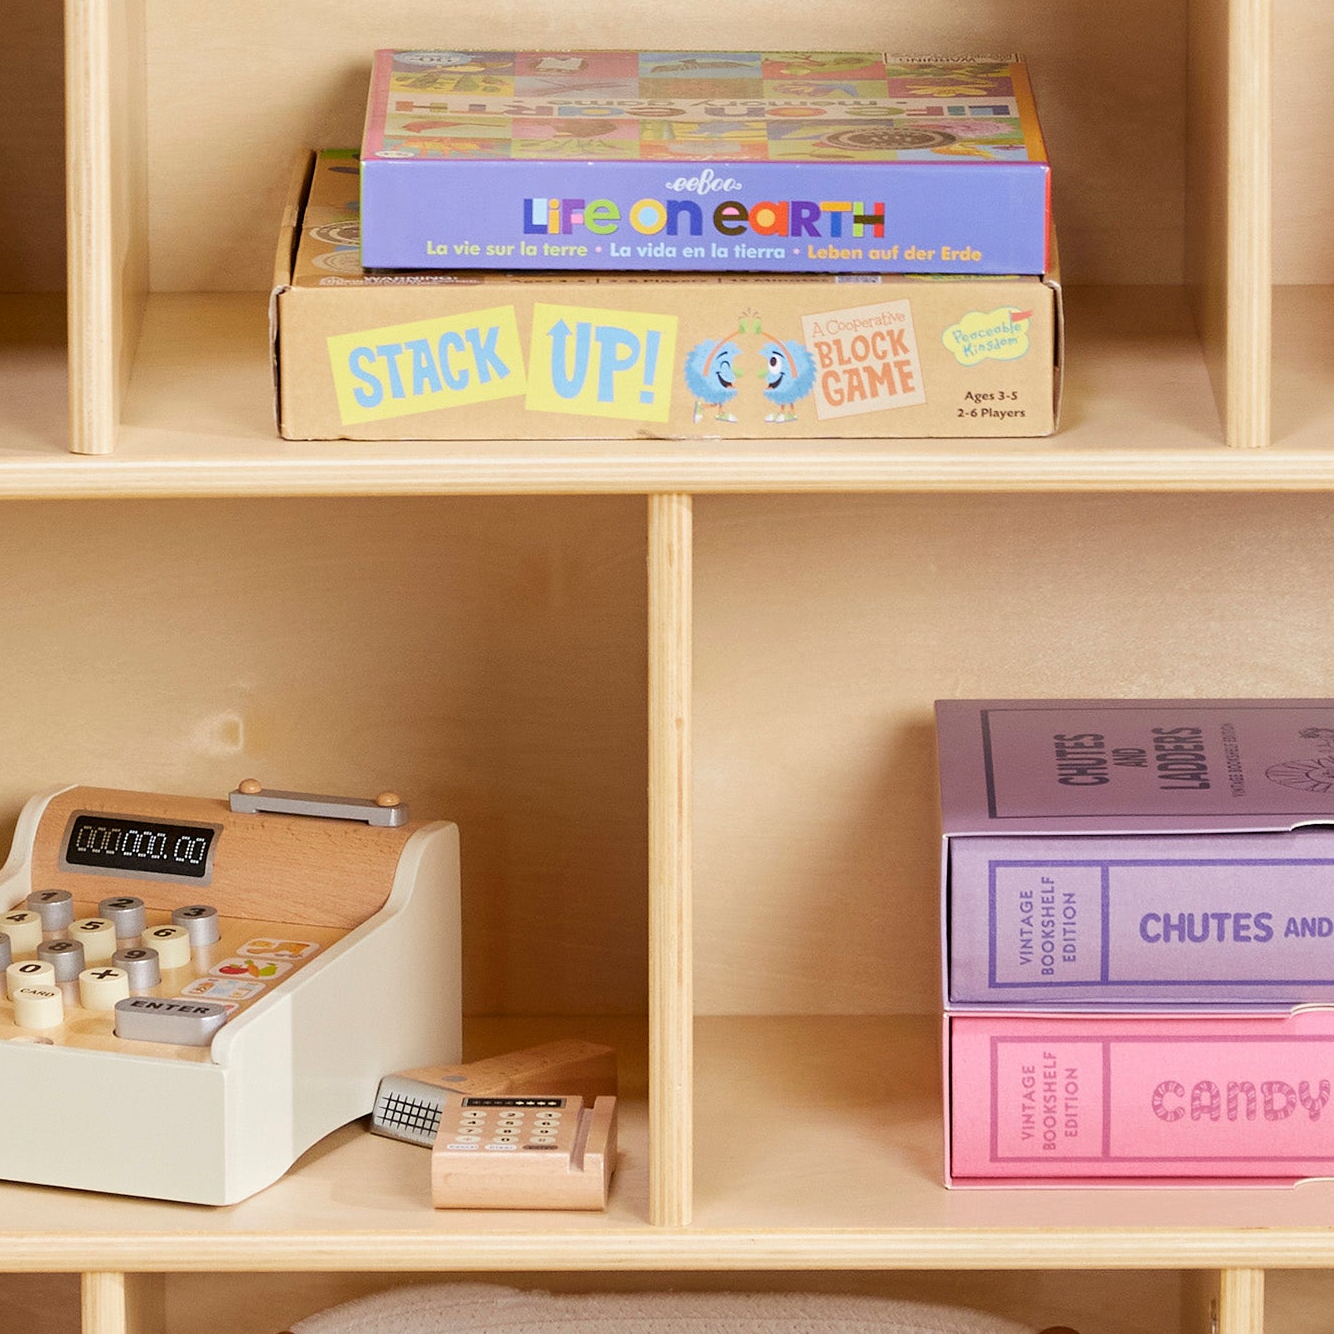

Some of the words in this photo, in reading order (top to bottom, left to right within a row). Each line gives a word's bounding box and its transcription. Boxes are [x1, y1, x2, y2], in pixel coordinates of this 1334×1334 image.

[629, 198, 703, 236] on
[427, 241, 448, 255] La
[454, 241, 481, 256] vie
[487, 244, 515, 256] sur
[520, 241, 538, 256] la
[543, 242, 588, 257] terre
[610, 243, 631, 257] La
[637, 242, 677, 258] vida
[683, 246, 705, 258] en
[711, 243, 729, 259] la
[733, 243, 785, 259] tierra
[807, 245, 865, 260] Leben
[869, 245, 899, 260] auf
[904, 245, 936, 260] der
[940, 246, 983, 261] Erde
[812, 322, 825, 338] A
[825, 310, 907, 335] Cooperative
[348, 325, 511, 409] STACK
[546, 318, 662, 405] UP!
[814, 328, 911, 369] BLOCK
[821, 359, 916, 407] GAME
[965, 391, 995, 402] Ages
[997, 390, 1019, 401] 3-5
[957, 408, 979, 418] 2-6
[981, 407, 1026, 420] Players
[1053, 733, 1110, 786] CHUTES
[1151, 727, 1211, 790] LADDERS
[1019, 889, 1034, 966] VINTAGE
[1041, 876, 1055, 976] BOOKSHELF
[1062, 892, 1076, 963] EDITION
[1139, 912, 1274, 944] CHUTES
[1283, 917, 1334, 938] AND
[130, 999, 211, 1015] ENTER
[1022, 1065, 1035, 1141] VINTAGE
[1043, 1052, 1057, 1151] BOOKSHELF
[1064, 1067, 1078, 1137] EDITION
[1152, 1079, 1331, 1123] CANDY
